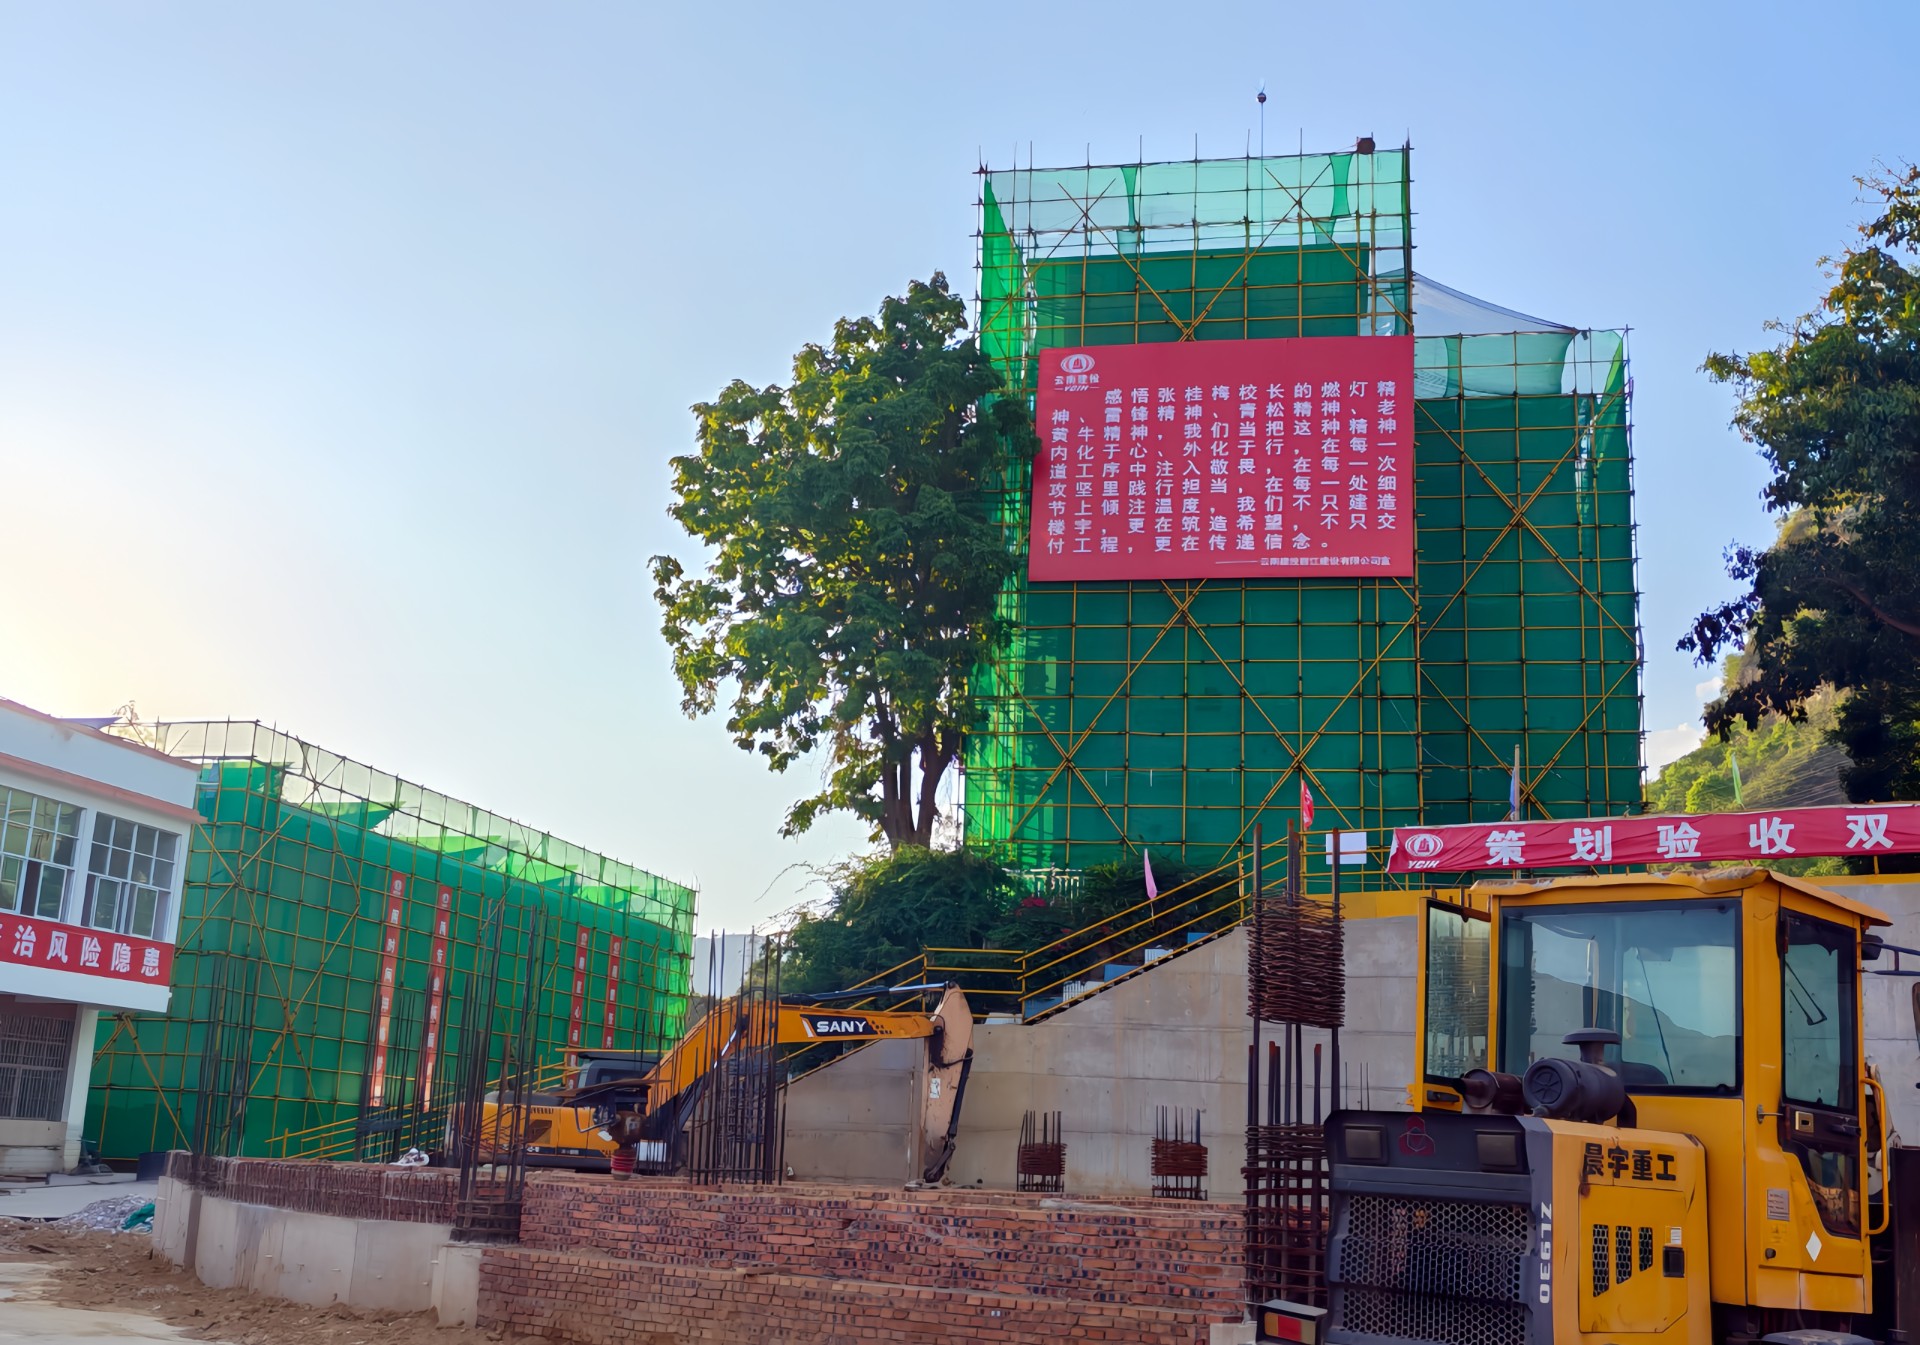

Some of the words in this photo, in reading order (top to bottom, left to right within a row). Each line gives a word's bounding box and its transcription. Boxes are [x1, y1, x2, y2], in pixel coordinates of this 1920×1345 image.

[1485, 814, 1894, 865] 策划验收双
[1408, 860, 1440, 869] YCIH
[0, 924, 160, 977] 治风险隐患
[816, 1020, 867, 1033] SANY
[1581, 1142, 1677, 1182] 晨宇重工
[1539, 1201, 1552, 1304] ZL930
